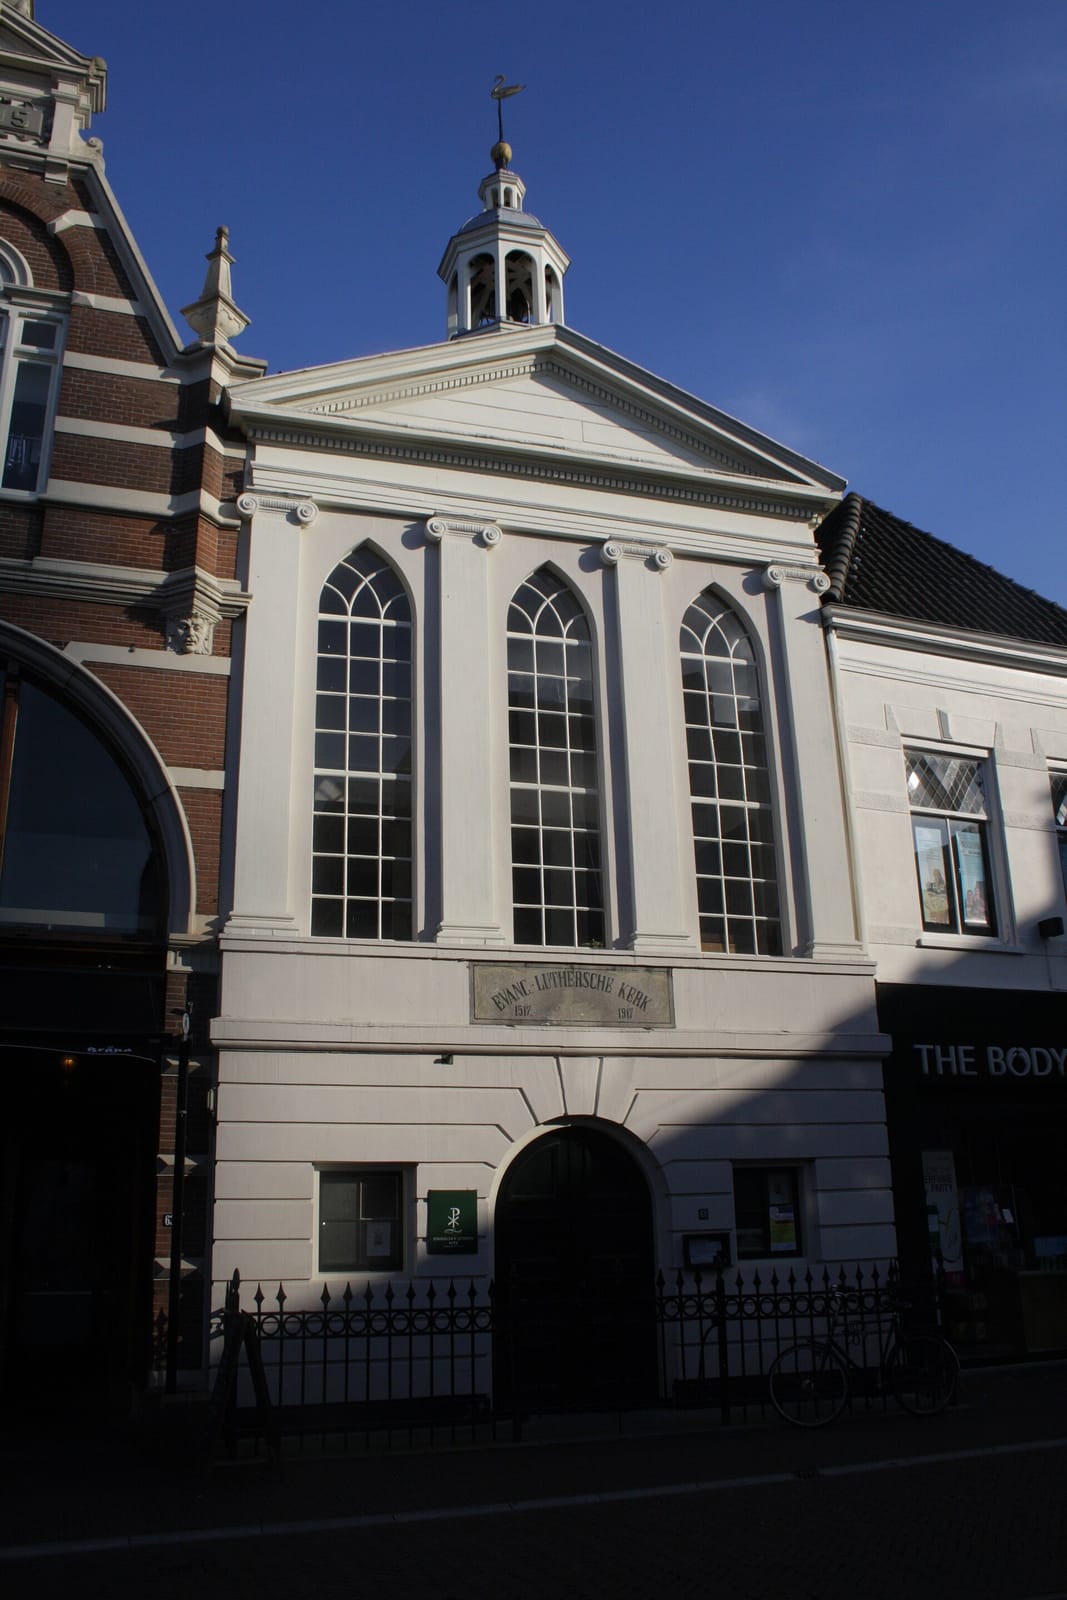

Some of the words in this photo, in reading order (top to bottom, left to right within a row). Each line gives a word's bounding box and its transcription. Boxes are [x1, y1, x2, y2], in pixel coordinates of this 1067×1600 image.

[534, 970, 615, 993] LUTHERSCHE
[618, 982, 653, 1012] KERK
[618, 1007, 634, 1019] 1917
[912, 1043, 978, 1076] THE
[985, 1045, 1067, 1078] BODY
